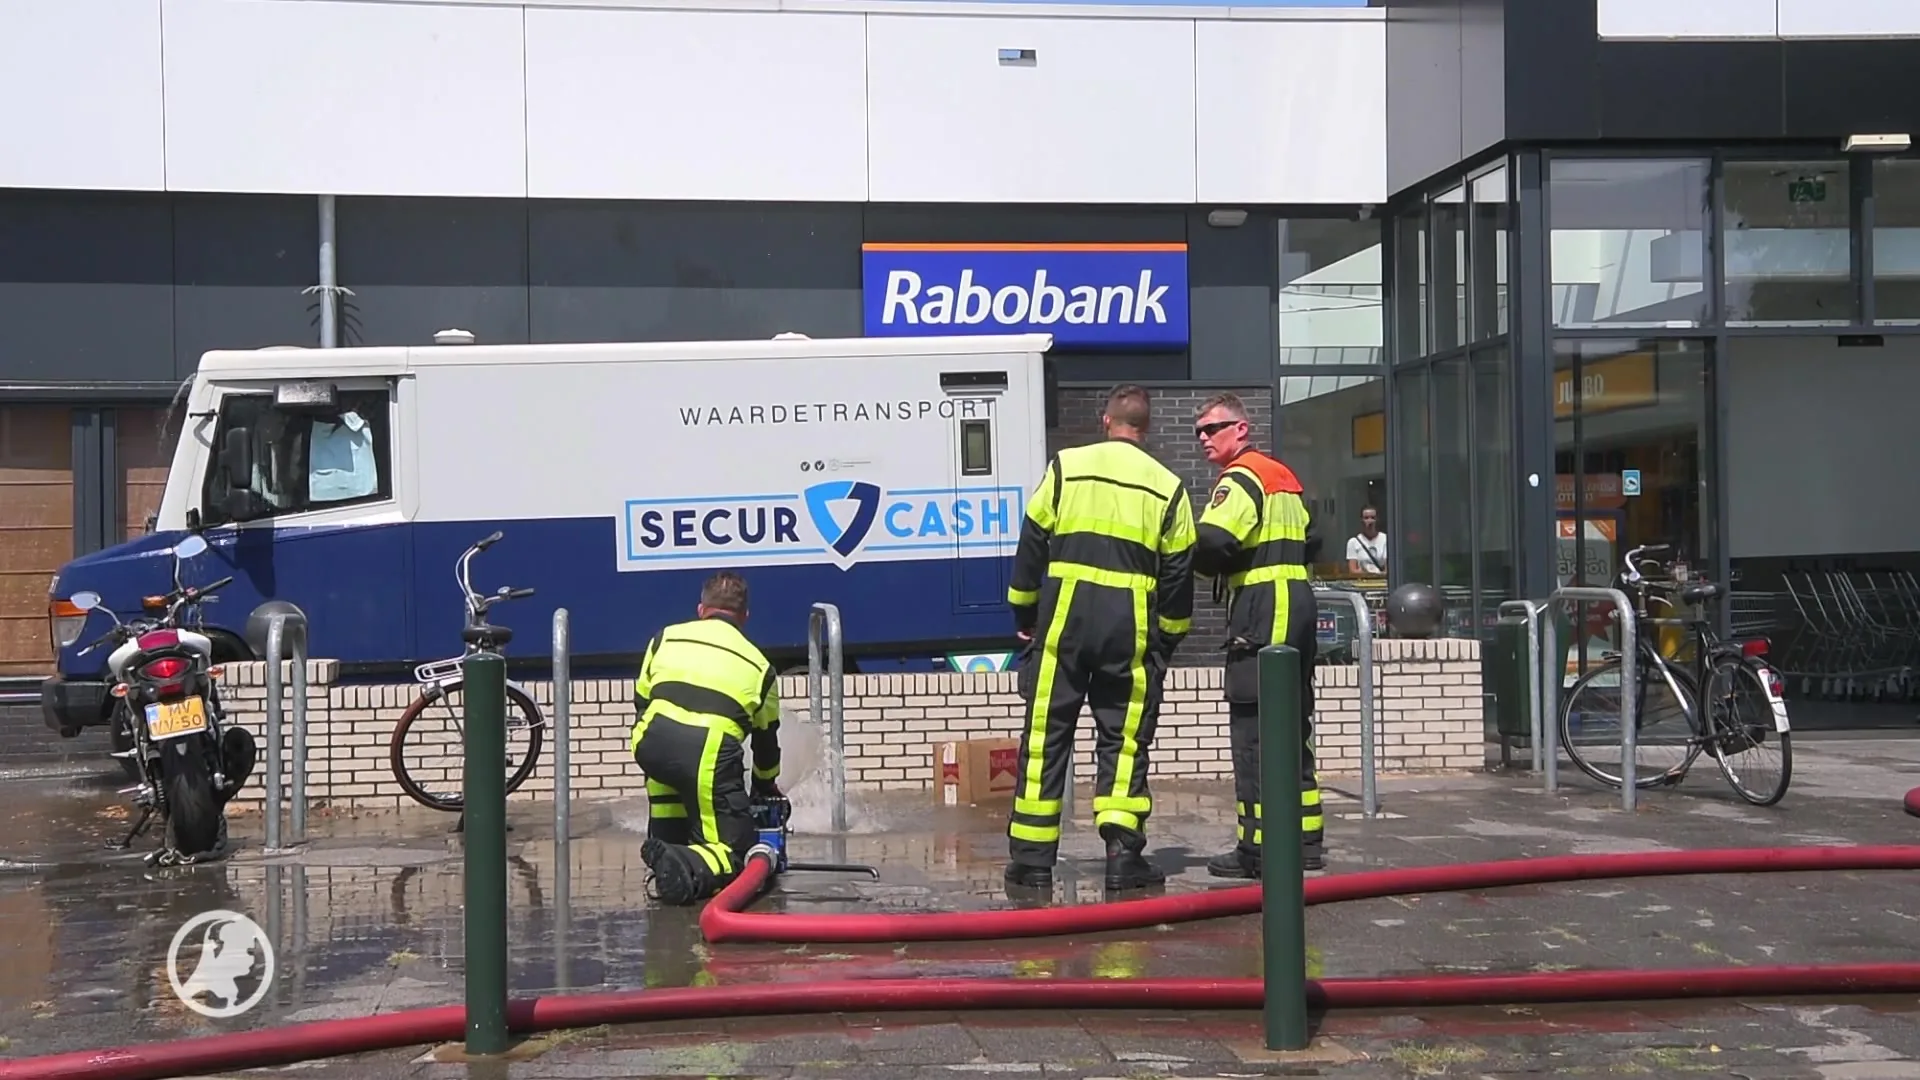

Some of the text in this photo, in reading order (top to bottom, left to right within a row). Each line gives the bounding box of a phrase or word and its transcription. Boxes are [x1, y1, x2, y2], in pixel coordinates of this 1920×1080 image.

[882, 269, 1169, 324] Rabobank
[1559, 374, 1604, 404] JUBO
[680, 400, 995, 426] WAARDETRANSPORT
[640, 498, 1009, 548] SECUR CASH
